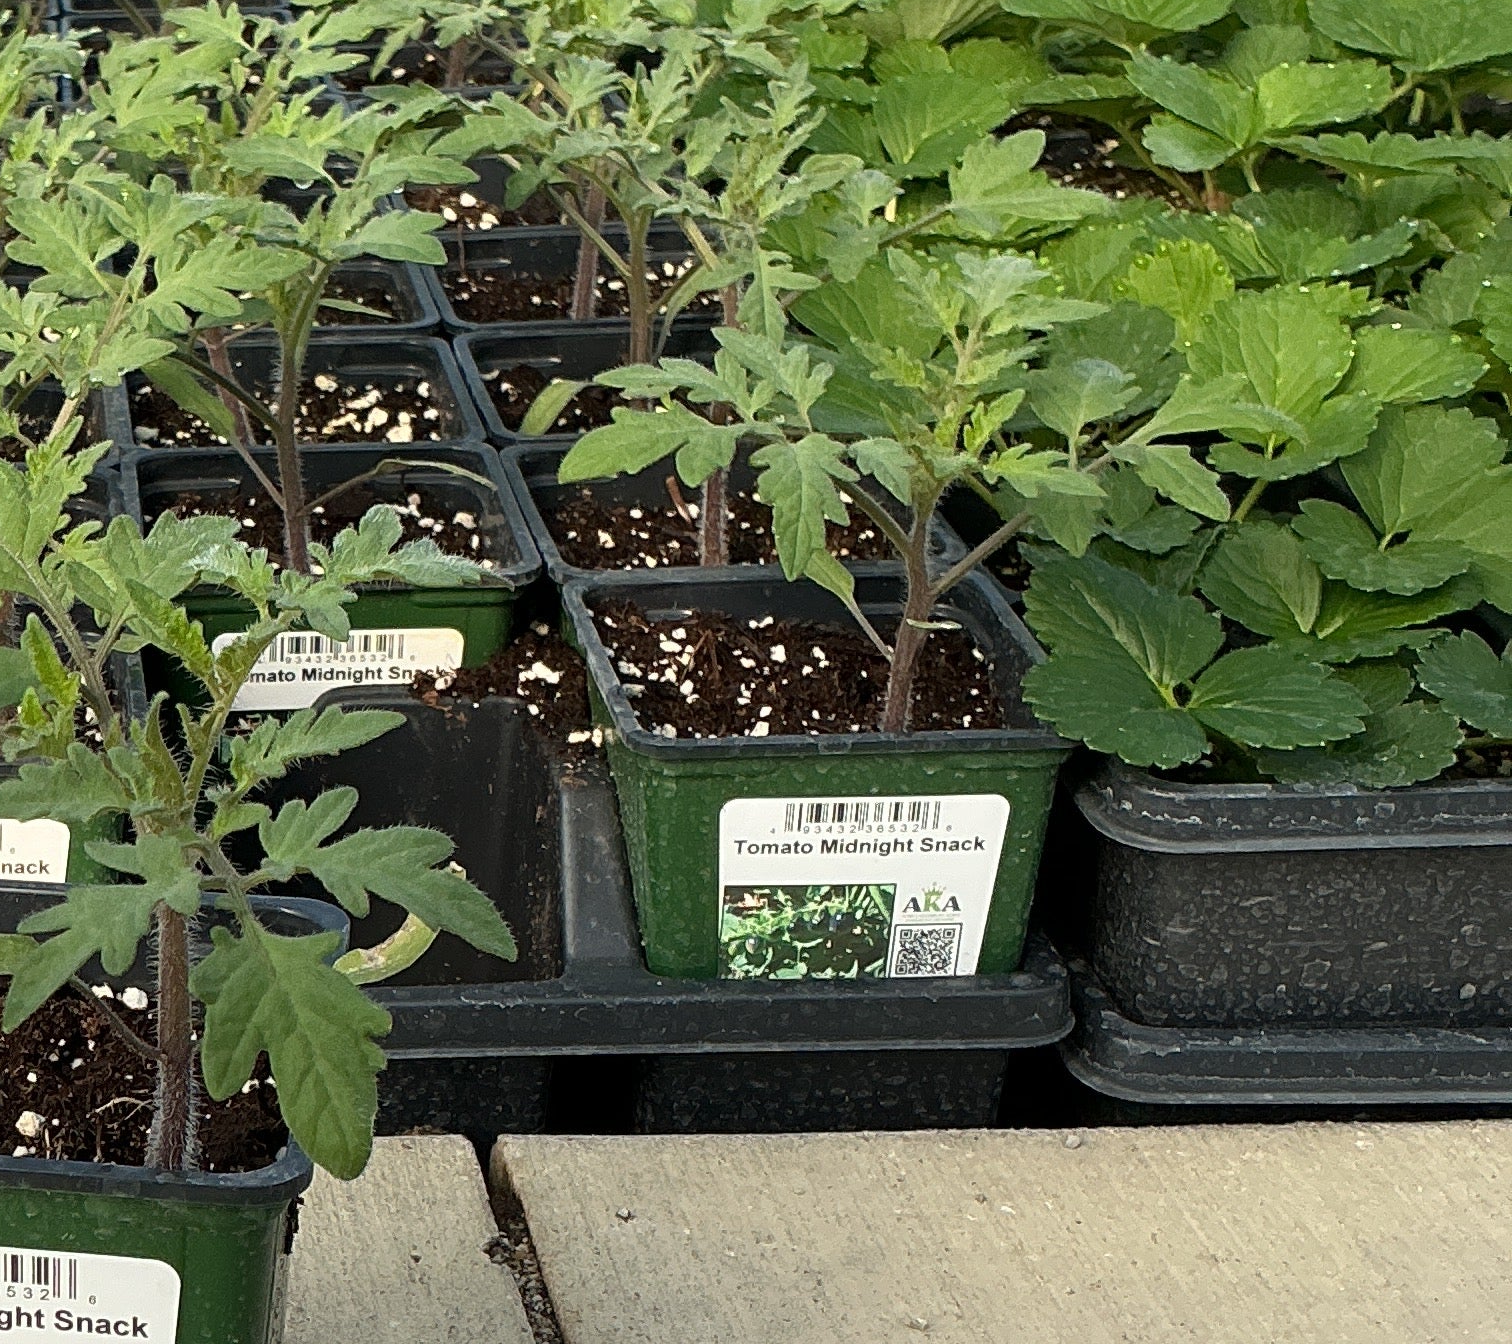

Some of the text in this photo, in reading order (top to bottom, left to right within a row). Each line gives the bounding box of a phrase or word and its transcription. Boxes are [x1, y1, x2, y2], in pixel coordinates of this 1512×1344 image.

[243, 669, 296, 683] mato
[301, 666, 383, 683] Midnight
[734, 836, 986, 857] Tomato Midnight Snack
[903, 895, 961, 912] AKA
[88, 1295, 97, 1305] 6
[53, 1309, 148, 1338] Snack
